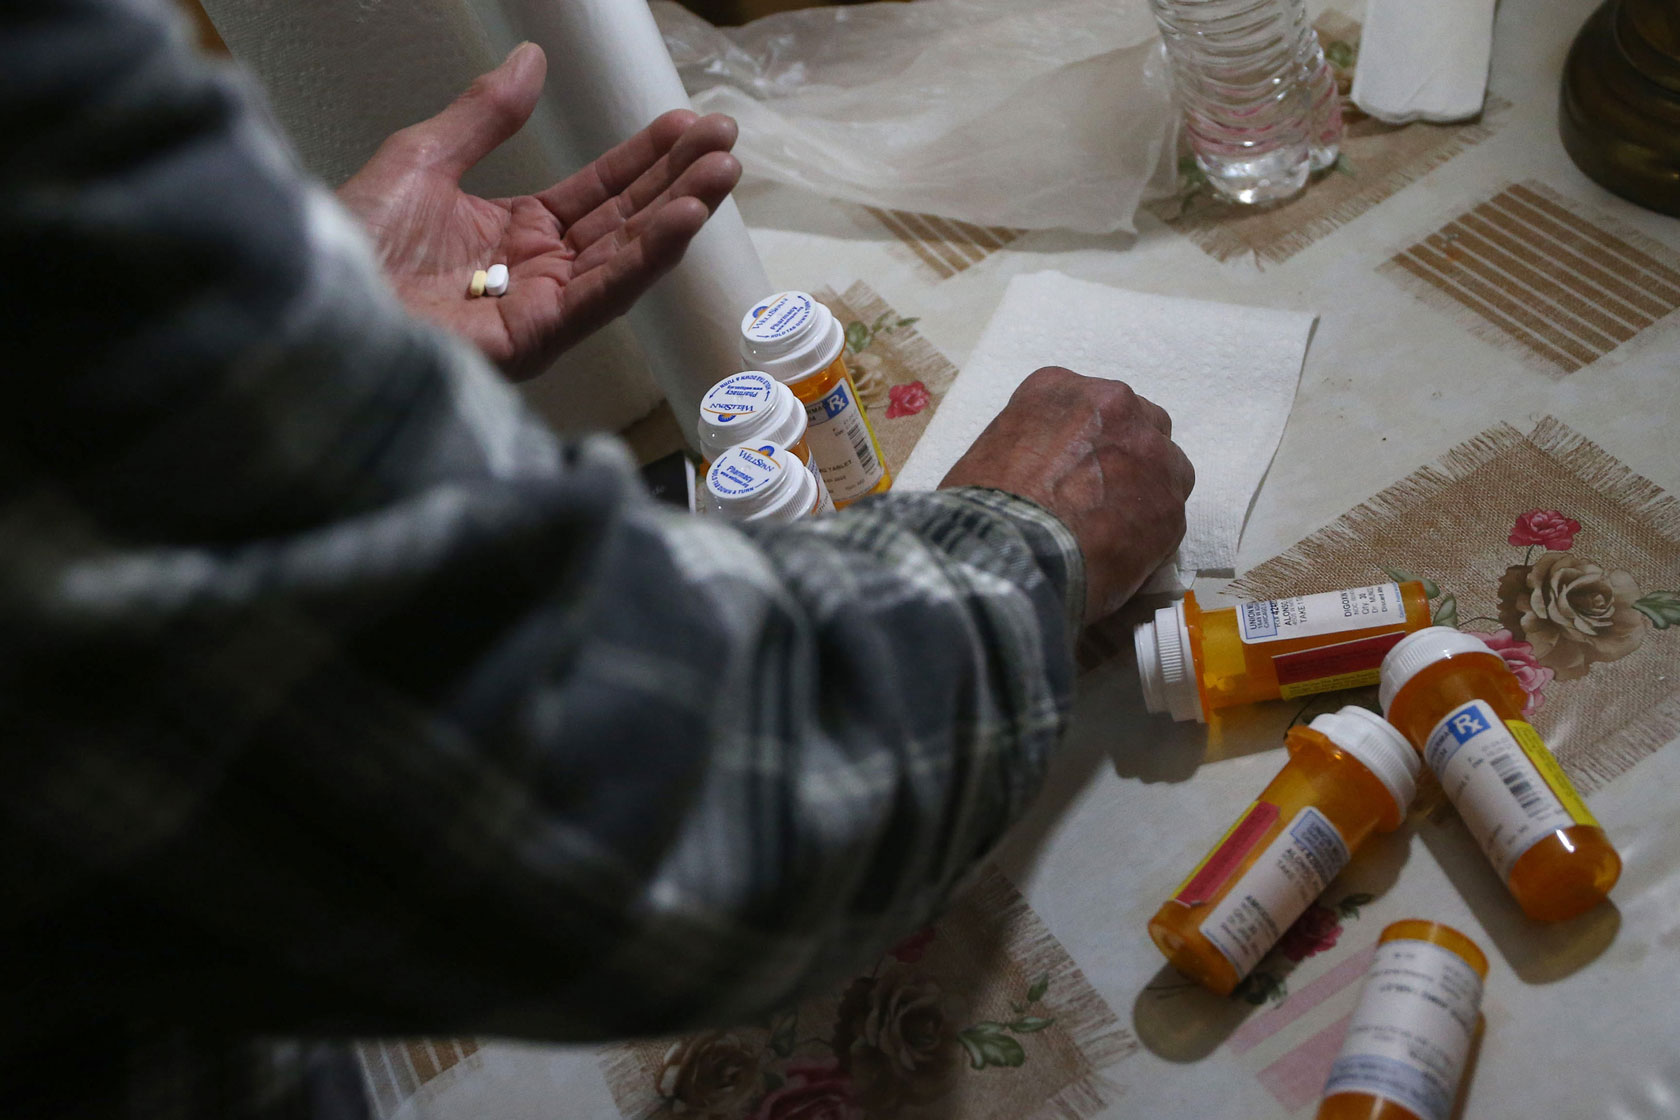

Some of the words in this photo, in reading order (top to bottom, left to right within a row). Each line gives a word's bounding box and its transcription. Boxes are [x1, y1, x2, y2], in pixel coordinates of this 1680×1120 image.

[770, 306, 797, 330] Pharmacy
[720, 379, 734, 388] TURN
[829, 394, 845, 411] Rx
[726, 465, 754, 483] Pharmacy
[717, 486, 731, 494] DOWN
[1298, 606, 1307, 622] TAKE
[1452, 714, 1483, 734] Rx
